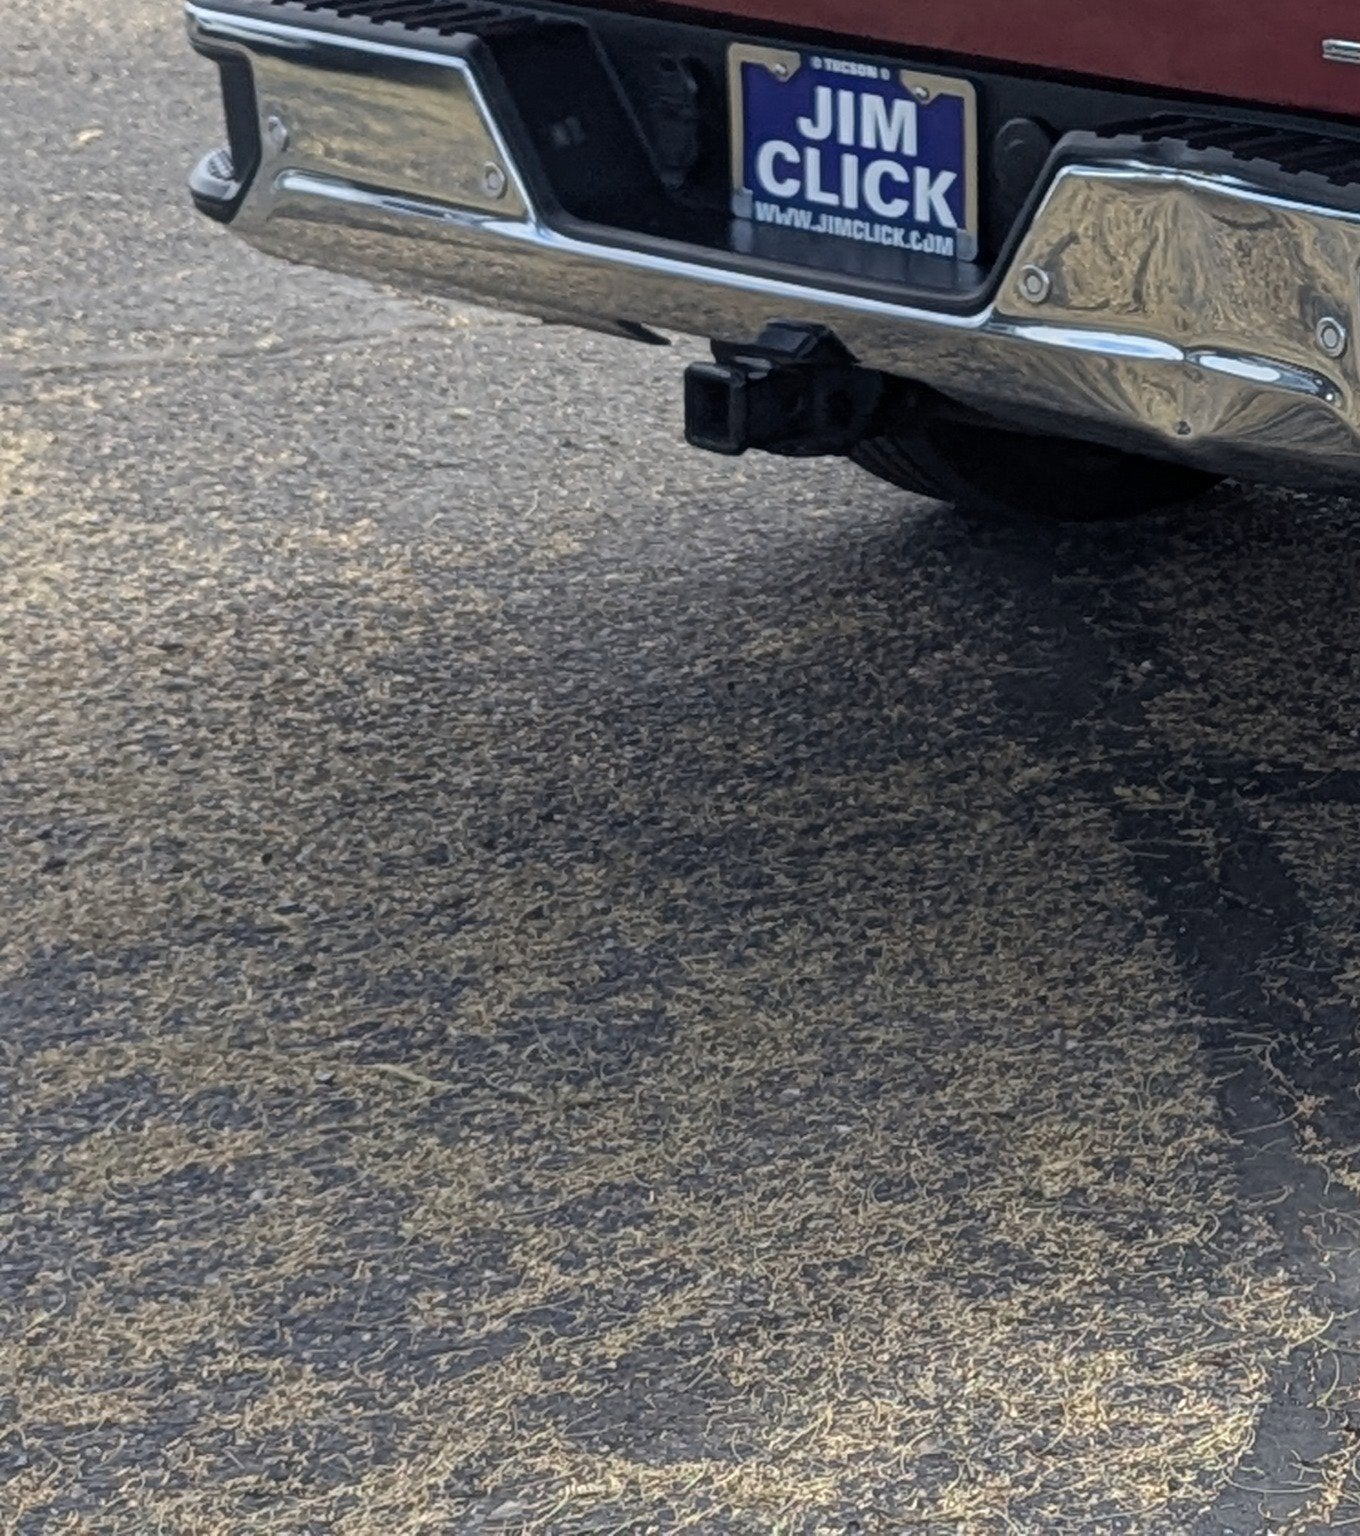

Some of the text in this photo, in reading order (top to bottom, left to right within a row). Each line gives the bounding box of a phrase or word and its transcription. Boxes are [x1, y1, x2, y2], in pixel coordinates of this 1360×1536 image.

[796, 85, 918, 157] JIM
[756, 139, 958, 229] CLICK
[755, 200, 954, 257] WWW.JIMCLICK.COM
